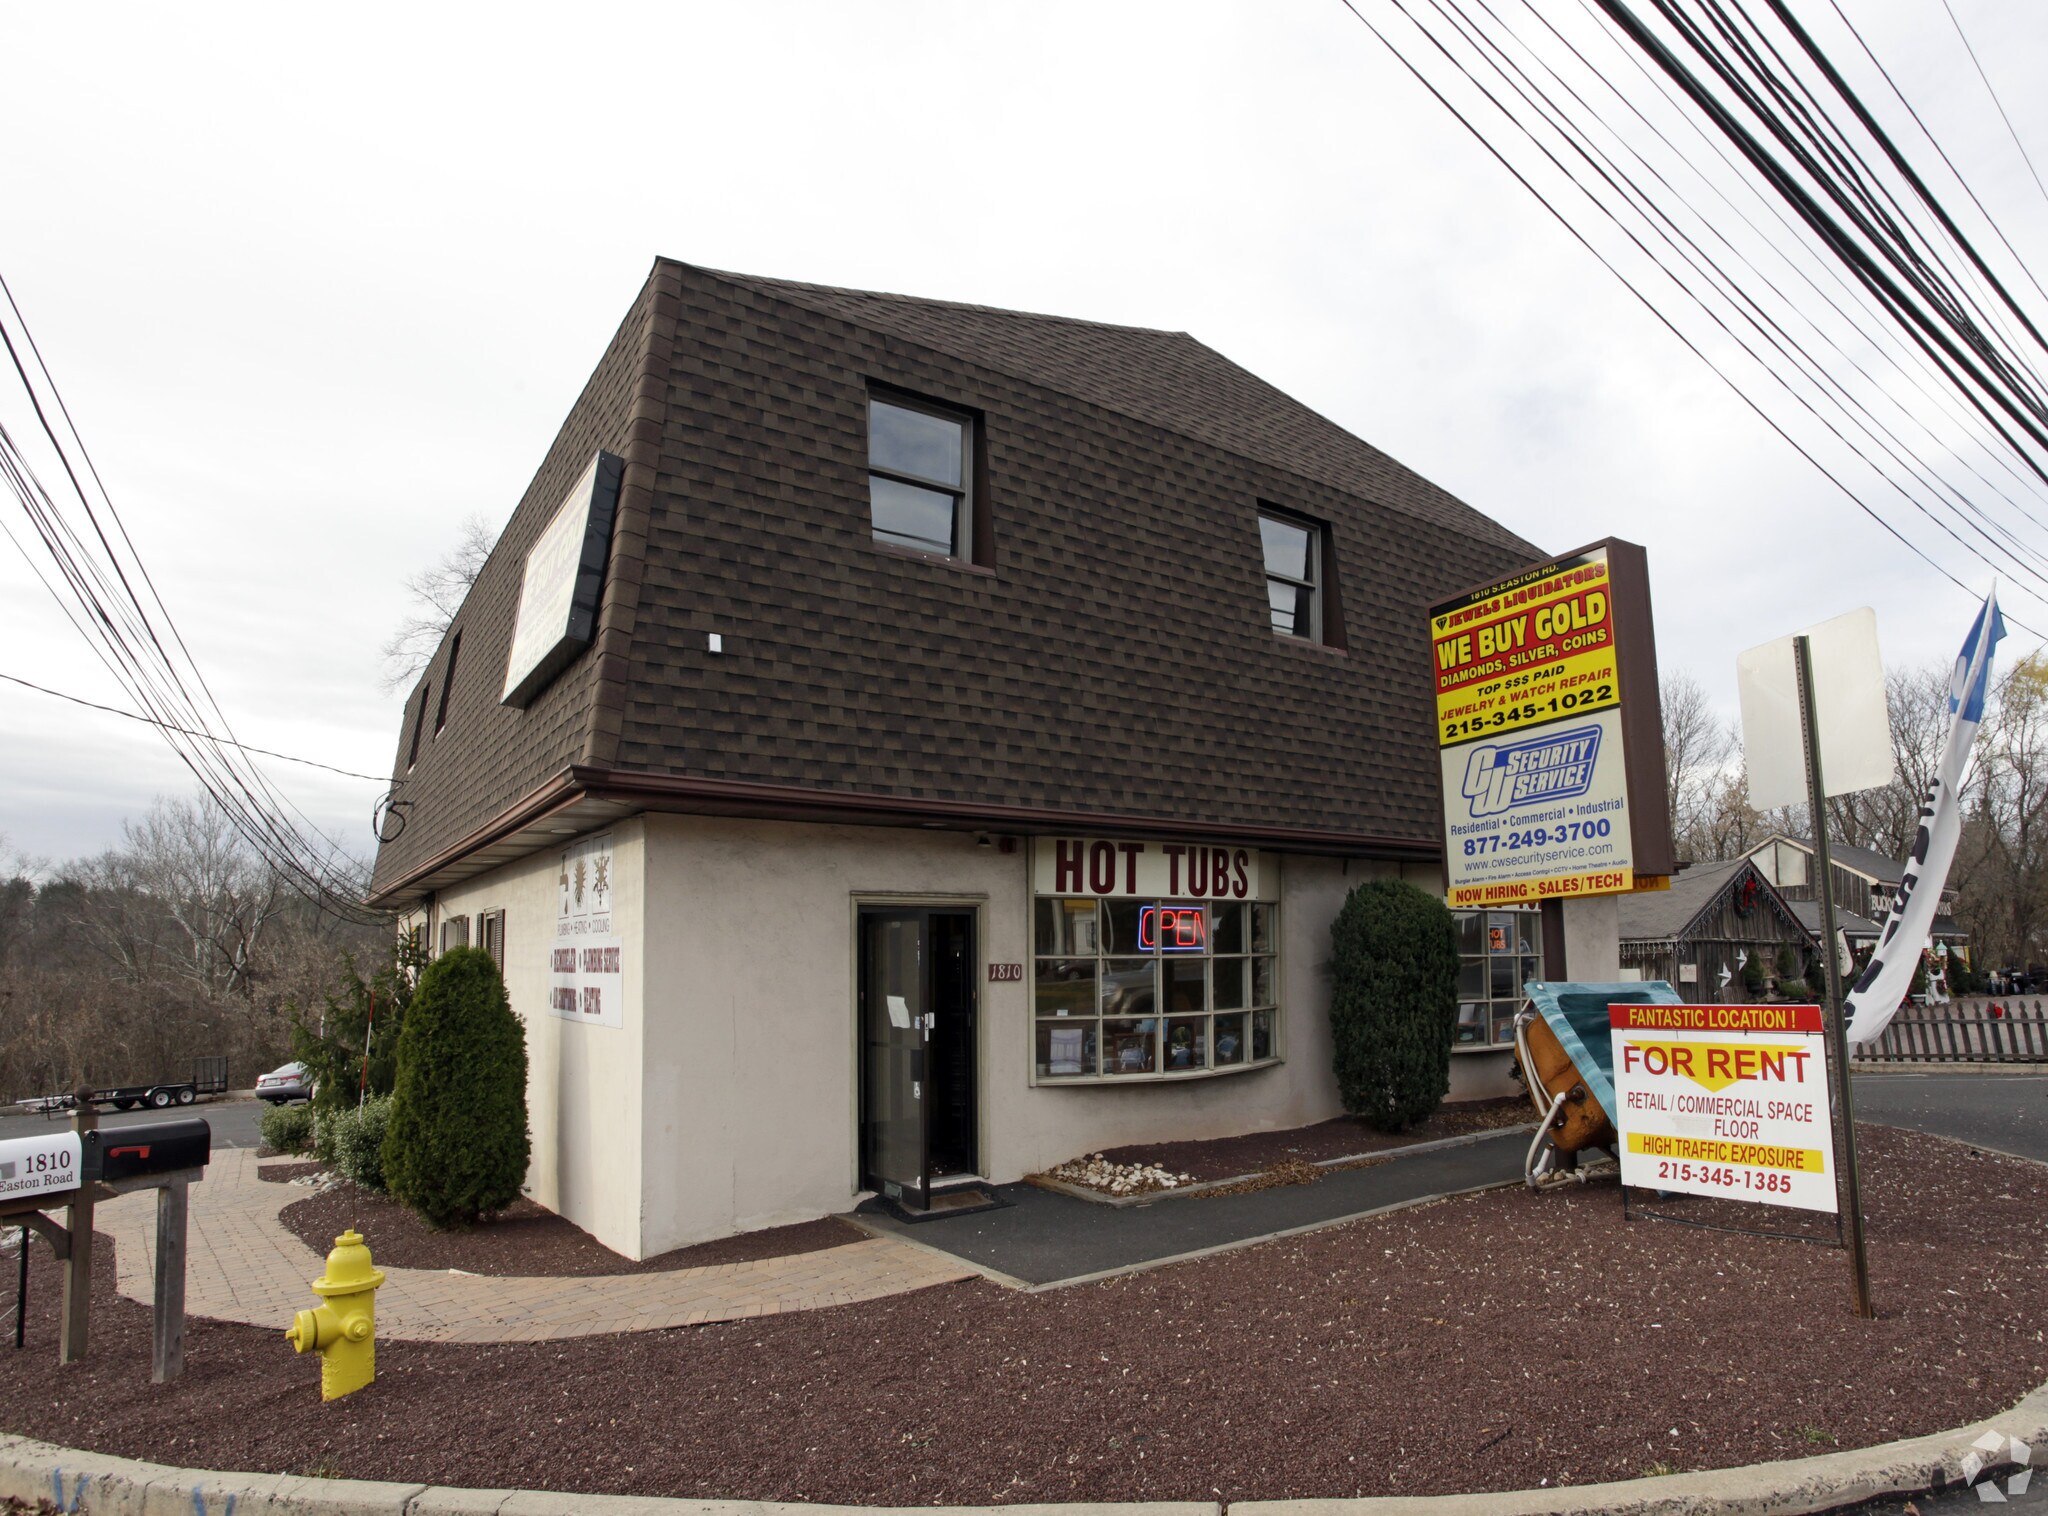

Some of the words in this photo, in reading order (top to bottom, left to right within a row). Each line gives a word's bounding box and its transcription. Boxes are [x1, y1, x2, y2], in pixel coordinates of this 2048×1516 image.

[1449, 600, 1500, 628] JEWELS
[1504, 562, 1606, 610] LIQUIDATORS
[1470, 589, 1490, 601] 1810
[1436, 633, 1472, 671] WE
[1478, 614, 1529, 661] BUY
[1534, 591, 1608, 642] GOLD
[1440, 660, 1507, 688] DIAMONDS,
[1509, 643, 1560, 670] SILVER,
[1562, 628, 1608, 652] COINS
[1440, 698, 1496, 721] JEWELRY
[1498, 694, 1506, 706] &
[1510, 682, 1556, 704] WATCH
[1559, 667, 1612, 690] REPAIR
[1477, 684, 1502, 698] TOP
[1504, 676, 1530, 690] $$$
[1533, 665, 1565, 682] PAID
[1446, 685, 1612, 738] 215-345-1022
[1505, 739, 1591, 776] SECURITY
[1514, 763, 1587, 800] SERVICE
[1450, 818, 1500, 836] Residential
[1509, 807, 1566, 827] Commercial
[1576, 797, 1624, 816] Industrial
[1464, 818, 1611, 856] 877-249-3700
[1056, 840, 1144, 895] HOT
[1162, 844, 1249, 899] TUBS
[1464, 842, 1612, 871] www.cwsecurityservice.com
[1456, 888, 1482, 902] NOW
[1486, 884, 1528, 900] HIRING
[1142, 909, 1205, 946] OPEN
[991, 964, 1021, 980] 1810
[1630, 1008, 1705, 1028] FANTASTIC
[1624, 1046, 1696, 1078] FOR
[1707, 1048, 1811, 1084] RENT
[1627, 1092, 1668, 1112] RETAIL
[1677, 1095, 1763, 1119] COMMERCIAL
[1768, 1102, 1813, 1123] SPACE
[1714, 1118, 1759, 1140] FLOOR
[26, 1150, 70, 1174] 1810
[1643, 1136, 1672, 1154] HIGH
[1676, 1138, 1727, 1162] TRAFFIC
[1731, 1144, 1804, 1170] EXPOSURE
[0, 1178, 40, 1192] Easton
[44, 1170, 73, 1186] Road
[1658, 1162, 1792, 1194] 215-345-1385
